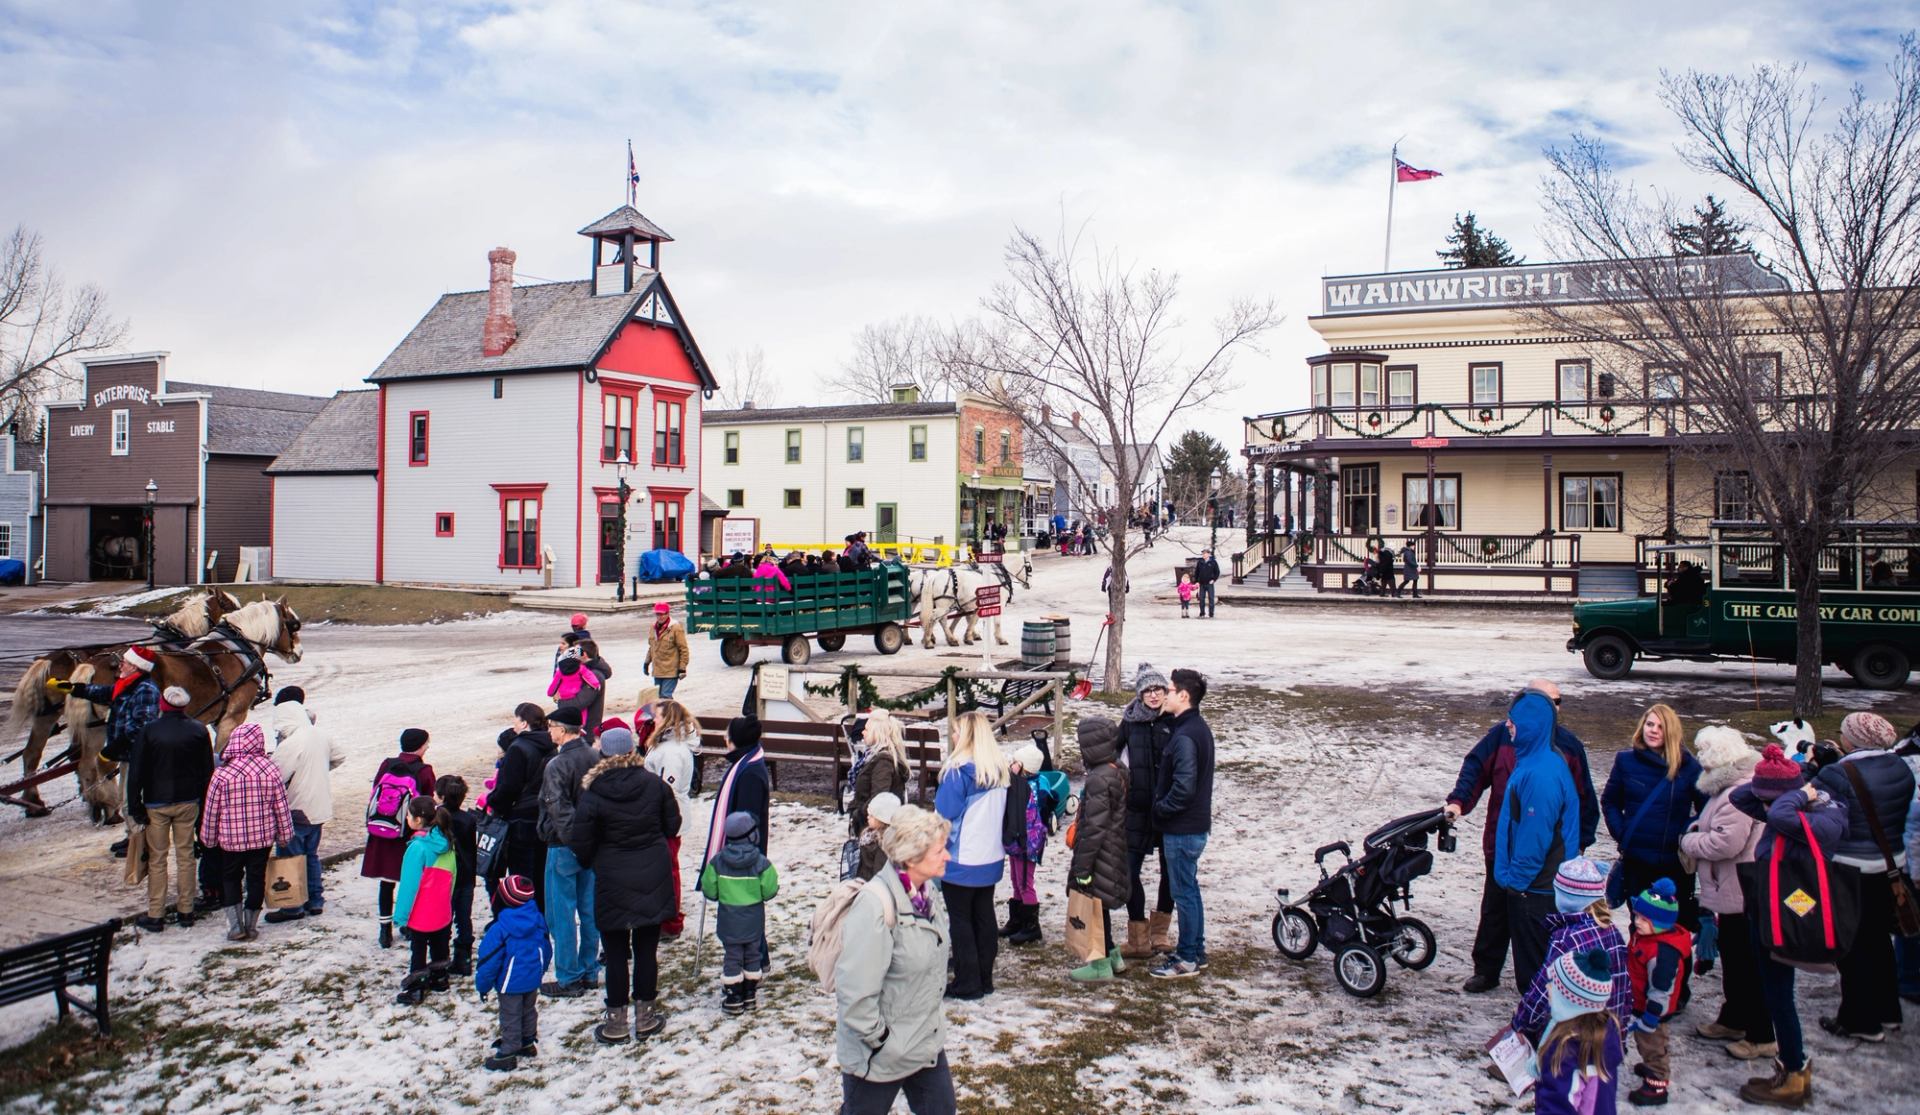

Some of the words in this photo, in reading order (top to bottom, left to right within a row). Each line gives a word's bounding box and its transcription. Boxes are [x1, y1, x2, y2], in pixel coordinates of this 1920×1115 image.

[1327, 272, 1573, 306] WAINWRIGHT
[94, 385, 151, 408] ENTERPRISE
[70, 424, 95, 437] LIVERY
[147, 420, 175, 433] STABLE
[995, 468, 1022, 476] BAKERY
[1731, 604, 1761, 617] THE
[1766, 605, 1838, 620] CALRY
[1841, 607, 1873, 621] CAR
